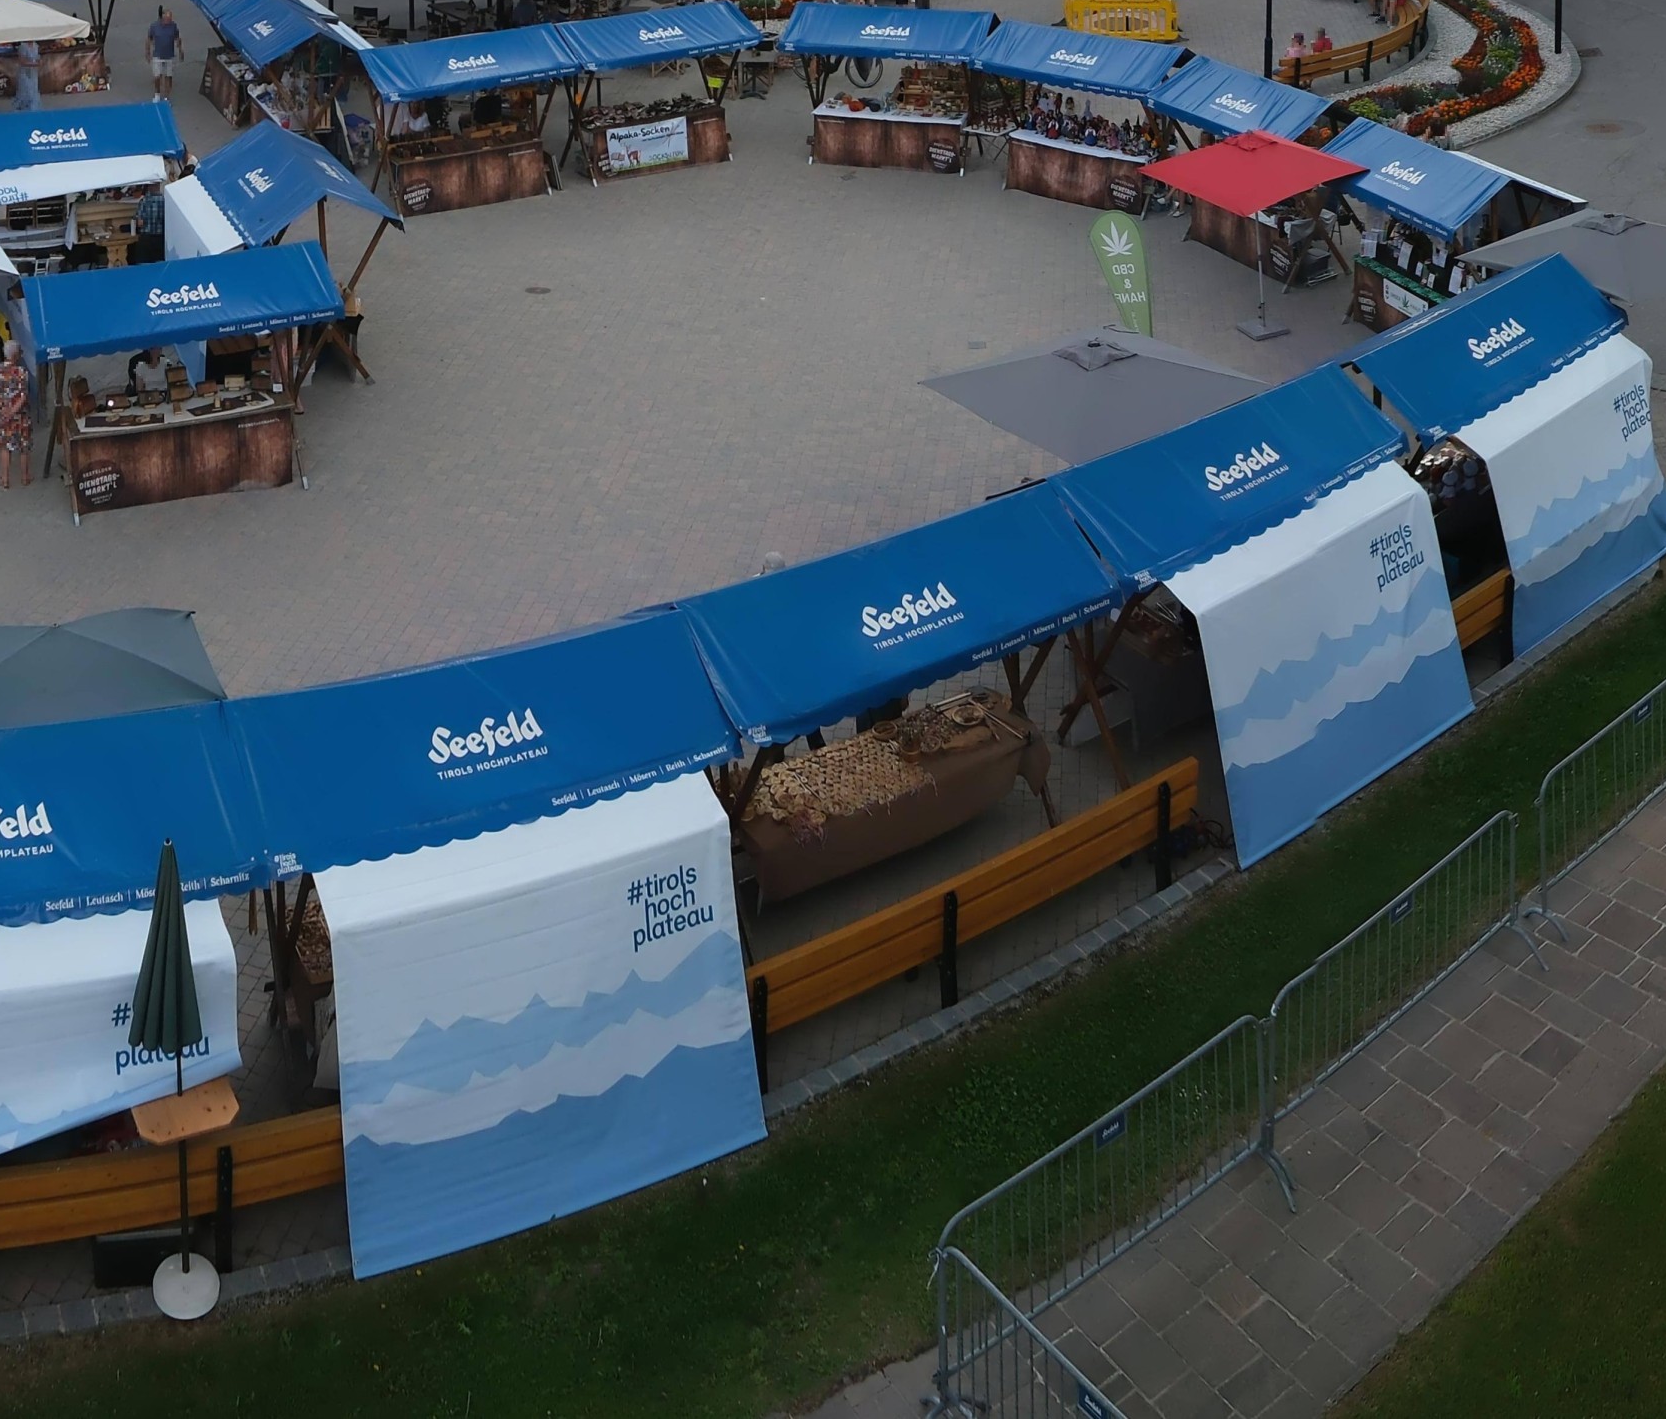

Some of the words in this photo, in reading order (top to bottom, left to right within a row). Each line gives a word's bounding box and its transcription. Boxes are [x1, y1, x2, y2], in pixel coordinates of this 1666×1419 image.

[639, 25, 684, 42] Seefeld
[860, 24, 910, 38] Seefeld
[448, 54, 497, 71] Seefeld
[1050, 49, 1099, 67] Seefeld
[1215, 93, 1258, 115] Seefeld
[29, 127, 88, 146] Seefeld
[608, 126, 671, 143] Alpaka-Socken
[1381, 160, 1428, 186] Seefeld
[146, 282, 220, 309] Seefeld
[1468, 317, 1526, 360] Seefeld
[1613, 384, 1645, 412] #tirols
[1622, 397, 1648, 424] hoch
[1205, 441, 1281, 492] Seefeld
[1220, 487, 1244, 502] TIROLS
[1245, 464, 1289, 490] HOCHPLATEAU
[1369, 523, 1412, 558] #tirols
[1381, 538, 1414, 567] hoch
[1377, 550, 1425, 592] plateau
[861, 581, 957, 638] Seefeld
[873, 632, 904, 651] TIROLS
[905, 612, 964, 640] HOCHPLATEAU
[428, 707, 544, 765] Seefeld
[437, 764, 474, 780] TIROLS
[476, 745, 549, 772] HOCHPLATEAU
[552, 791, 578, 807] Seefeld
[587, 779, 621, 798] Leutasch
[629, 767, 657, 784] Mösern
[666, 758, 686, 772] Reith
[693, 744, 728, 763] Scharnitz
[45, 897, 74, 912] Seefeld
[86, 891, 124, 908] Leutasch
[210, 871, 250, 888] Scharnitz
[628, 864, 698, 906] #tirols
[644, 884, 696, 920] hoch
[634, 903, 714, 952] plateau
